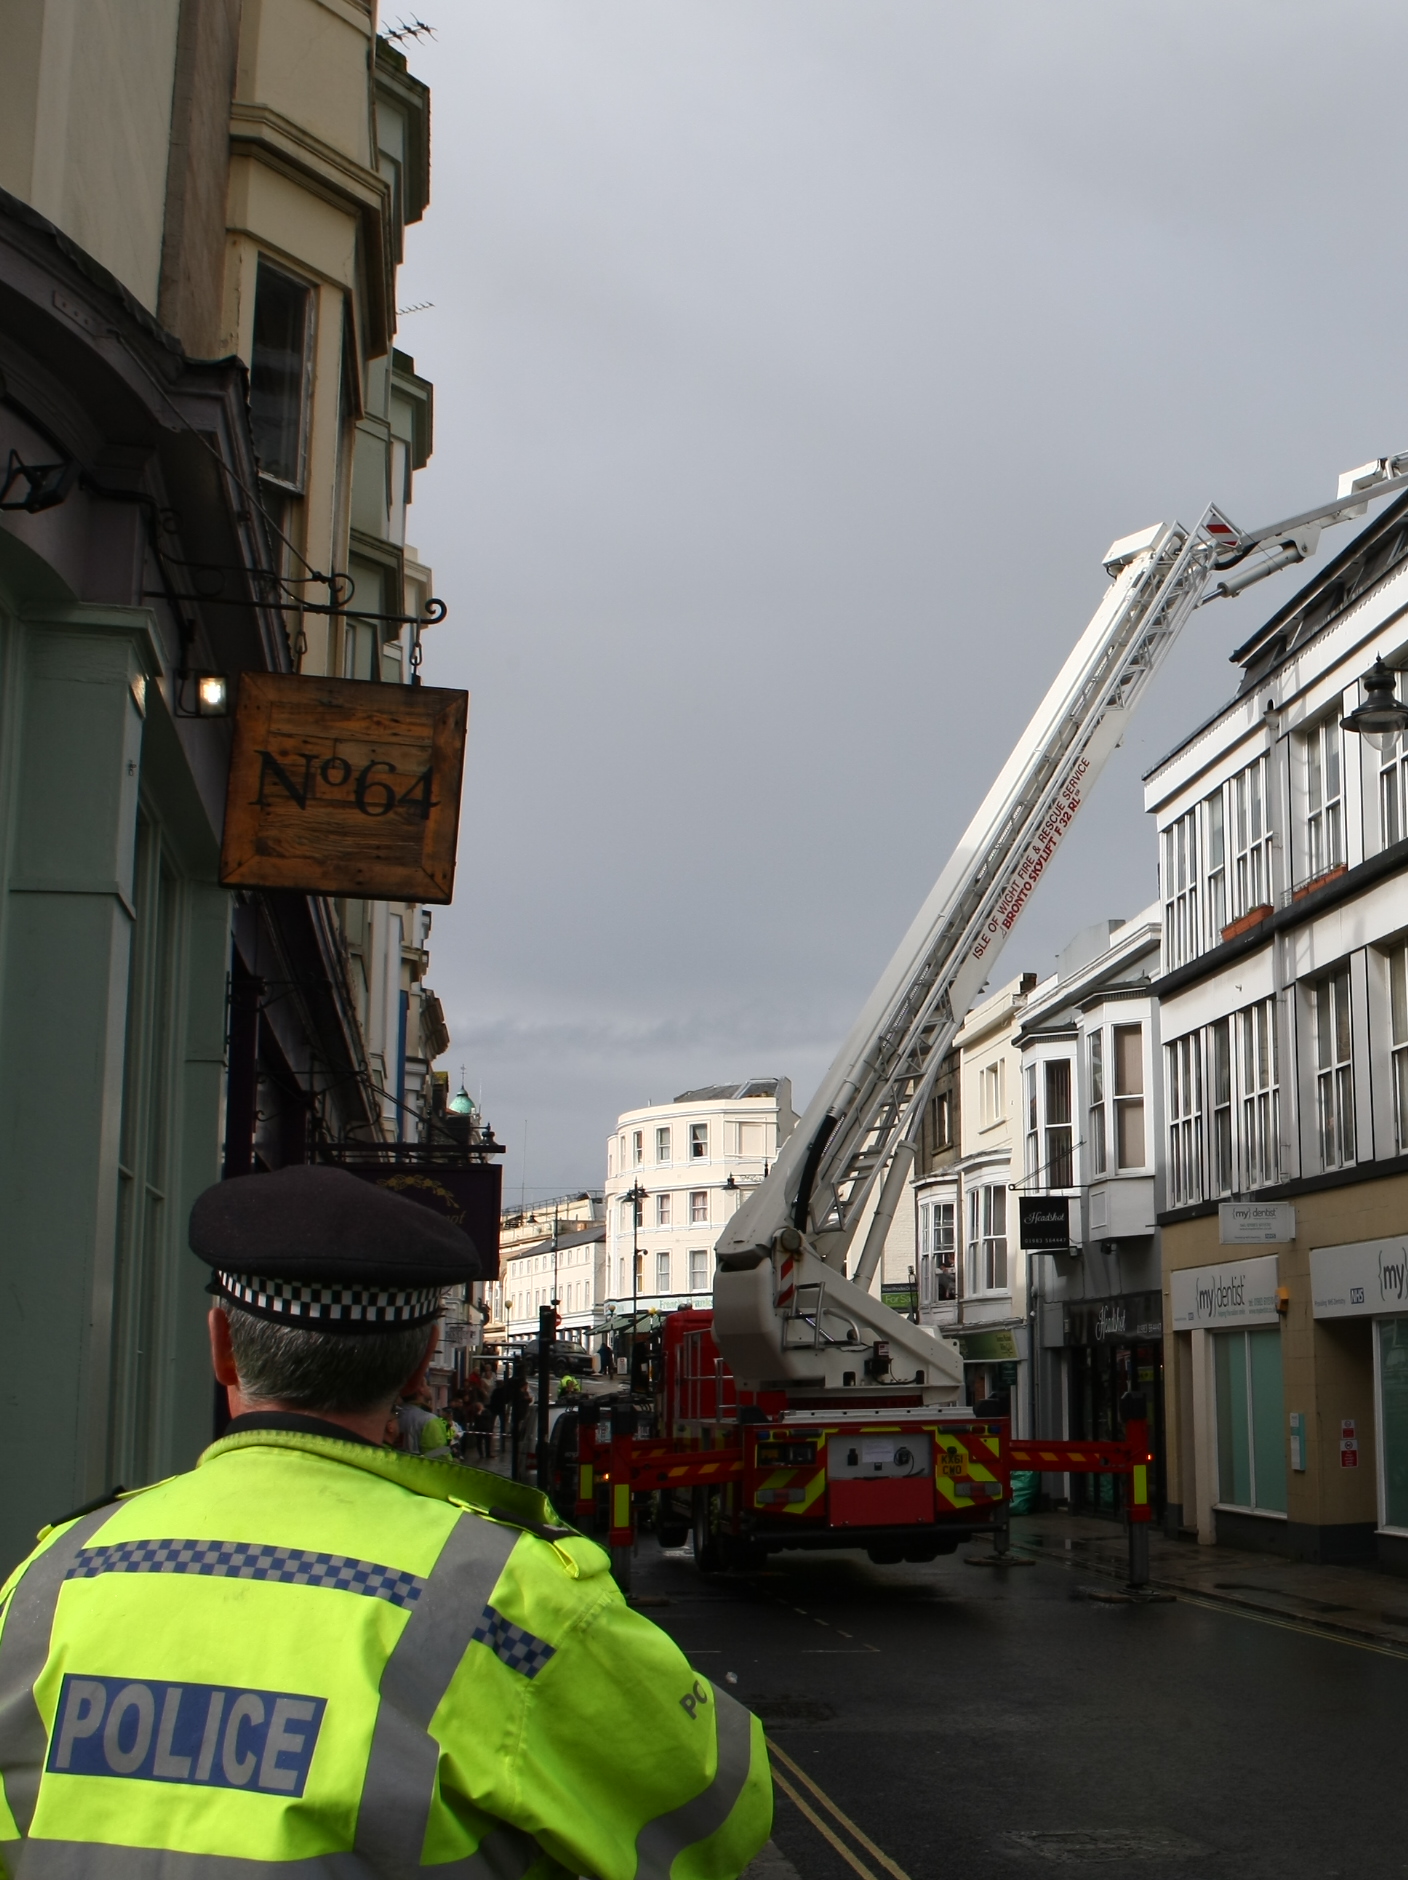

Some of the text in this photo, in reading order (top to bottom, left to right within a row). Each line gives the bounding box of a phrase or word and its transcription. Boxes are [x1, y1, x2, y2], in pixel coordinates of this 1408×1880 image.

[972, 935, 992, 960] ISLE
[988, 917, 1001, 934] OF
[997, 879, 1021, 918] WIGHT
[1017, 855, 1036, 881] FIRE
[1032, 845, 1041, 856] &
[1038, 800, 1066, 844] RESCUE
[1062, 756, 1091, 802] SERVICE
[1002, 882, 1033, 930] BRONTO
[1028, 836, 1057, 883] SKYLIFT
[1054, 826, 1063, 838] F
[1059, 812, 1073, 829] 32
[1023, 1211, 1066, 1225] Headshot
[885, 1294, 899, 1304] For
[1350, 1288, 1364, 1303] NHS
[55, 1679, 317, 1791] POLICE
